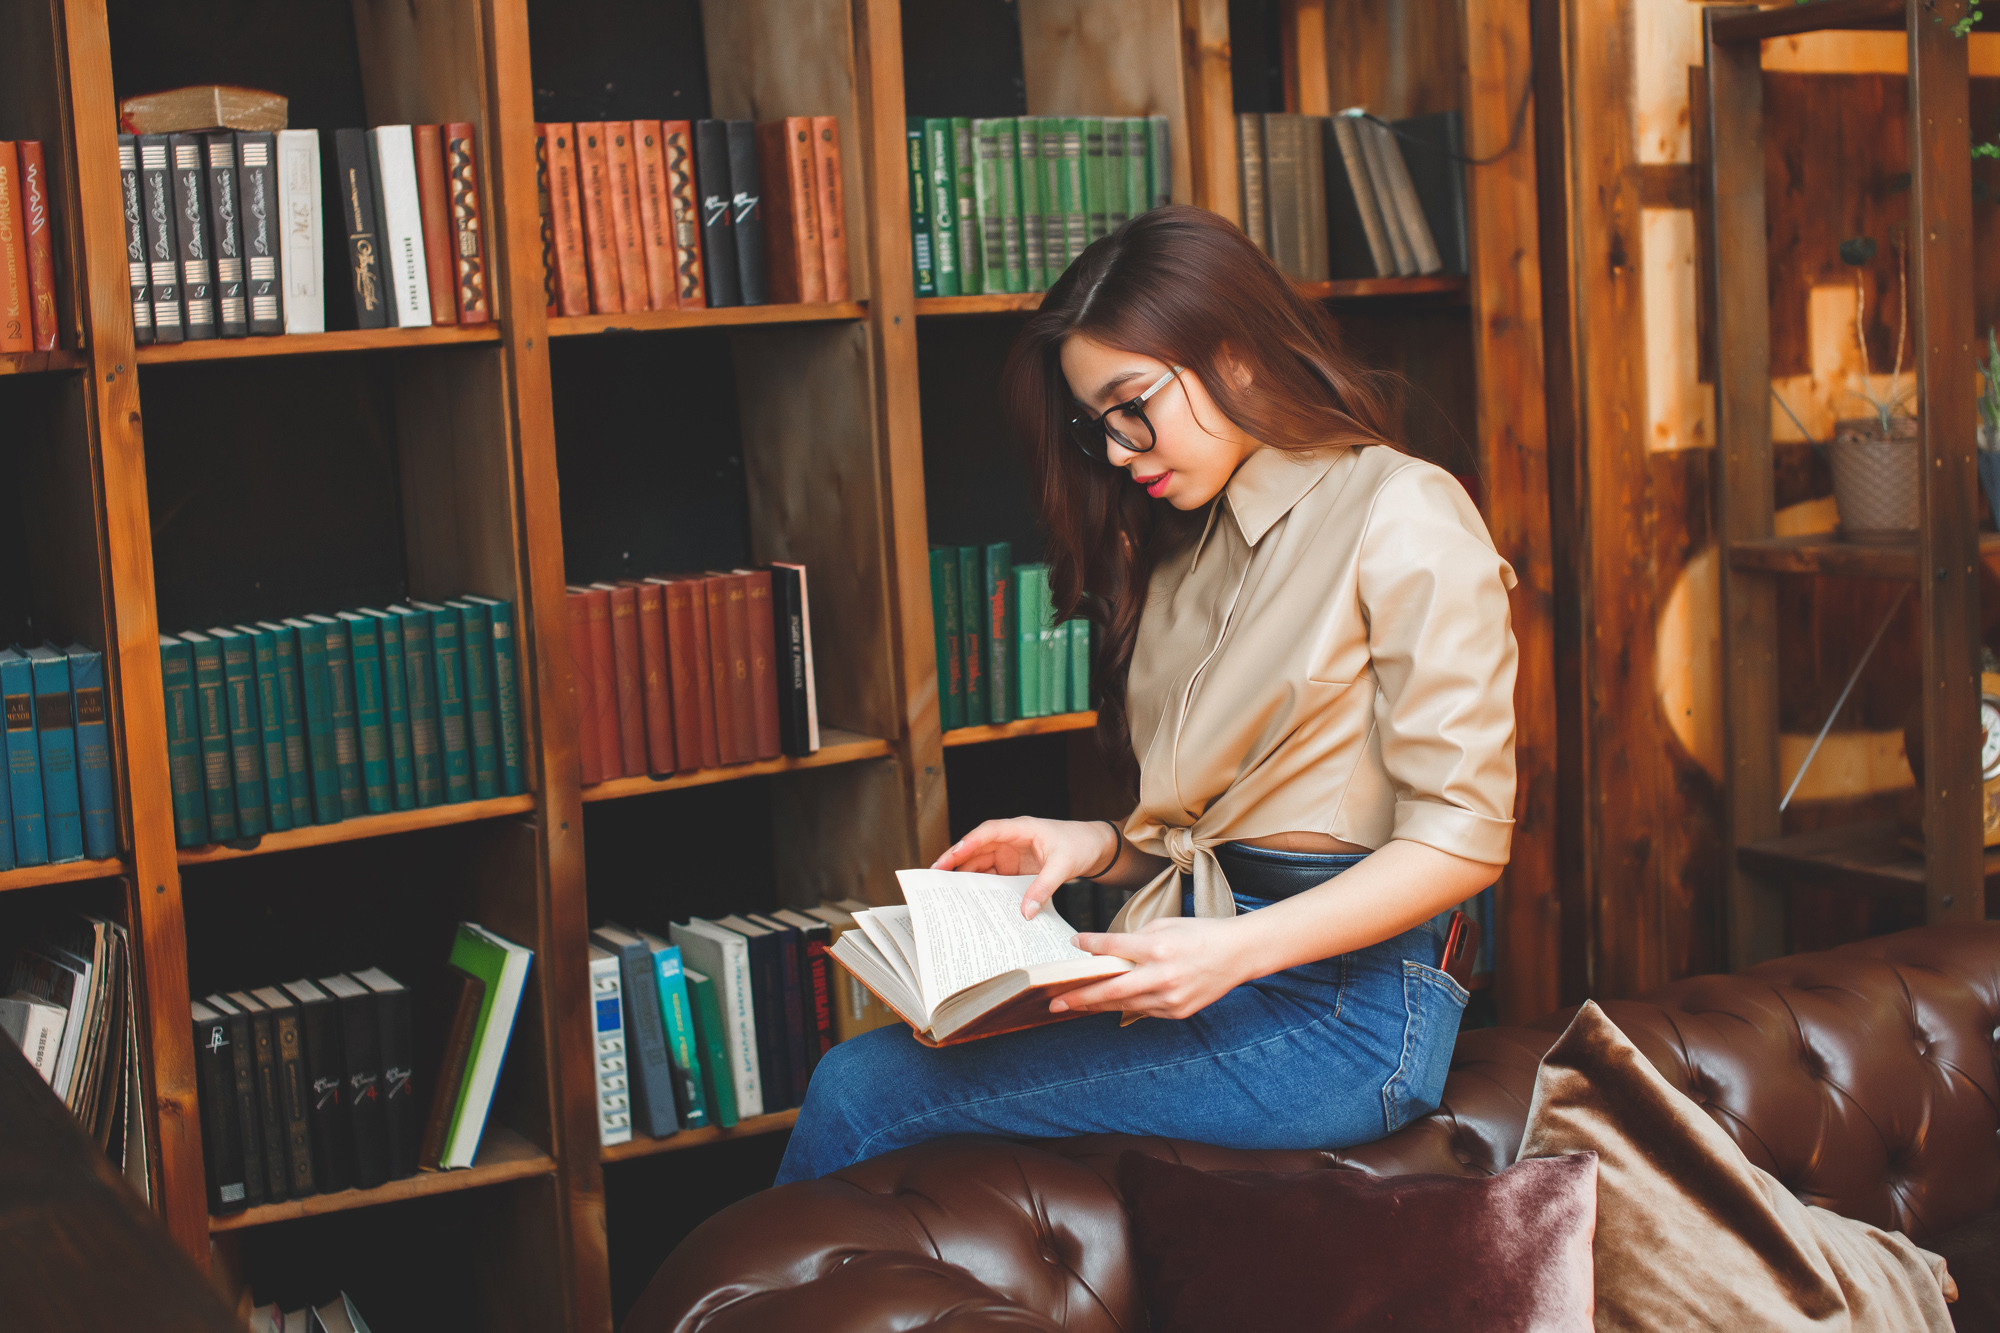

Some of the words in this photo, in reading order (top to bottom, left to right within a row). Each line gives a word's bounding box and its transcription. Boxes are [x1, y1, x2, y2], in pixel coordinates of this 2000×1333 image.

[0, 165, 14, 243] СИМОНОВ
[5, 242, 20, 317] Константин
[257, 281, 271, 295] 5
[160, 287, 172, 300] 2
[194, 285, 206, 298] 3
[227, 283, 239, 297] 4
[7, 320, 22, 340] 2
[735, 658, 747, 680] 8
